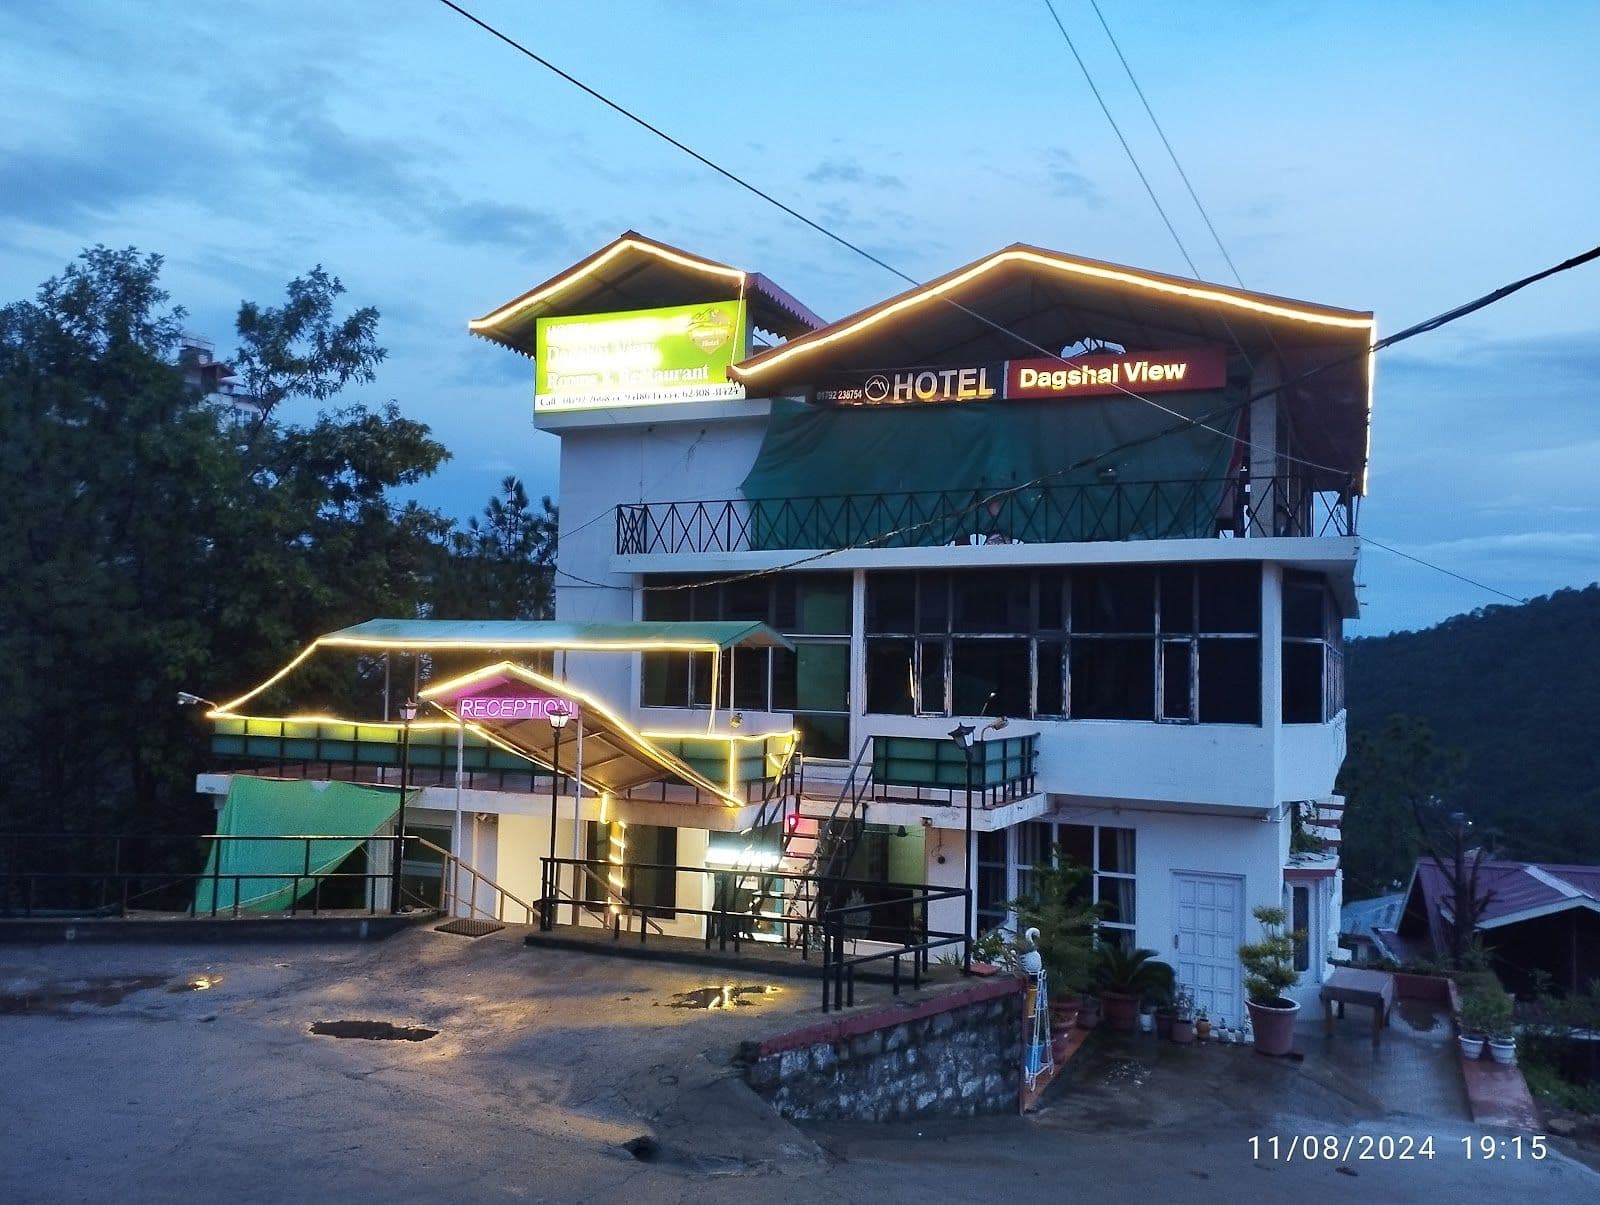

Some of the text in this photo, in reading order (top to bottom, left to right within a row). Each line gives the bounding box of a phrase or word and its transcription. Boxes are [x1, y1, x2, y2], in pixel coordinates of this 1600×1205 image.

[1124, 361, 1187, 383] View
[893, 367, 996, 401] HOTEL
[460, 699, 573, 717] RECEPTION
